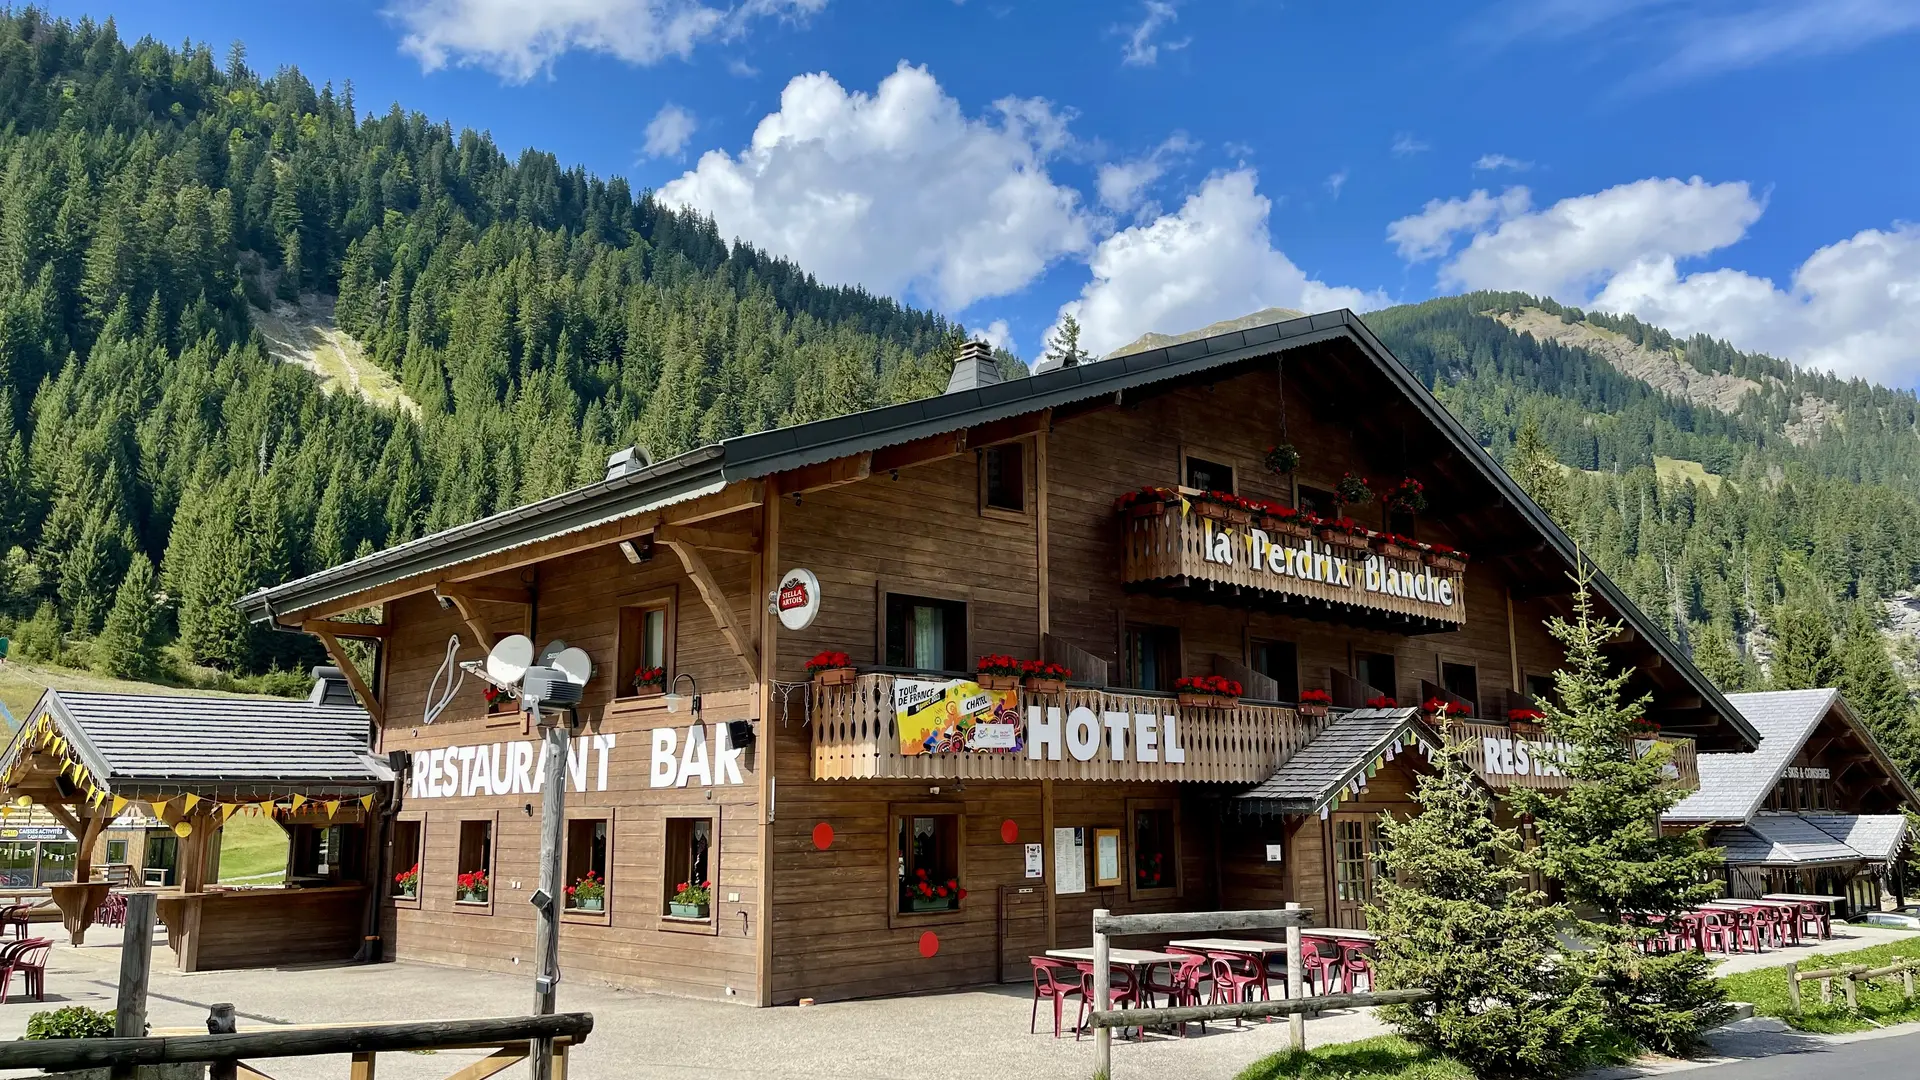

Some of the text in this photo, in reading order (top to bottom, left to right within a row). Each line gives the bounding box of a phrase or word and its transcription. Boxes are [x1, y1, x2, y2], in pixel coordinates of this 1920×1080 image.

[1204, 520, 1453, 606] la Perdrix Blanche
[782, 589, 802, 599] STELLA
[782, 596, 803, 606] ARTOIS
[898, 696, 908, 707] DE
[909, 688, 935, 703] FRANCE
[899, 684, 918, 697] TOUR
[1028, 706, 1185, 763] HOTEL
[650, 722, 744, 789] BAR
[1787, 767, 1799, 778] SKIS
[1799, 767, 1804, 778] &
